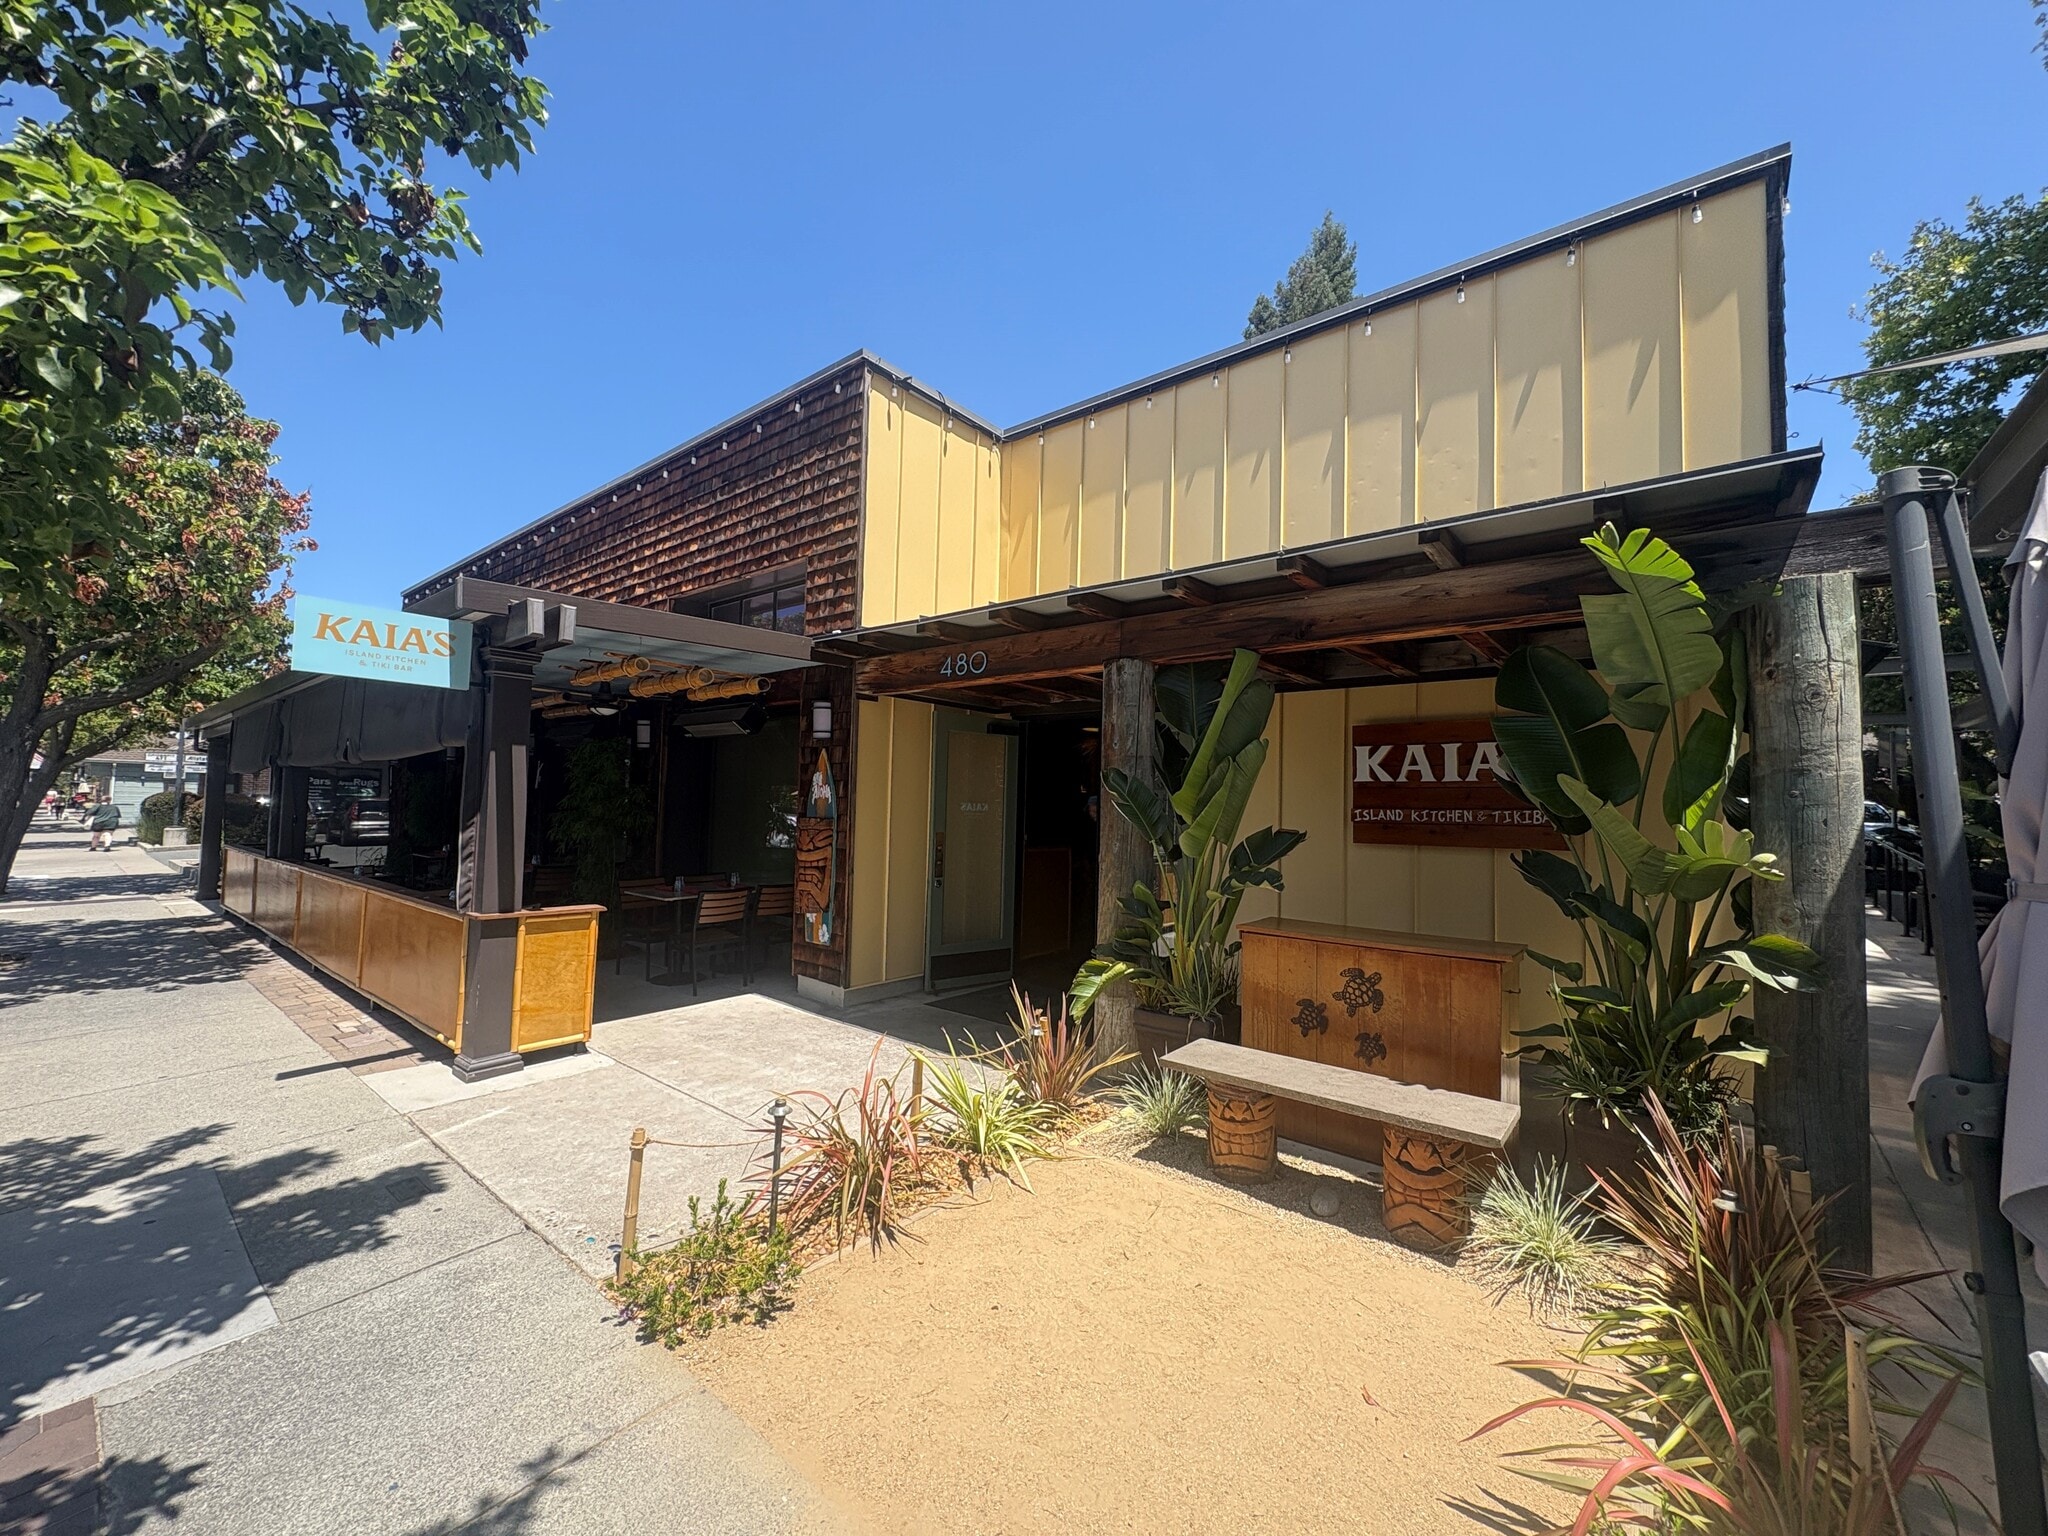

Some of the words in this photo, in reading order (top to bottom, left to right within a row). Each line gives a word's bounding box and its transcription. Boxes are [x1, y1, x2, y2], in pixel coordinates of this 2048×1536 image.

[312, 612, 457, 658] KAIA'S
[345, 649, 382, 659] ISLAND
[385, 655, 426, 665] KITCHEN
[940, 651, 987, 677] 480
[372, 661, 390, 669] TIKI
[394, 663, 413, 672] BAR
[1354, 808, 1404, 822] ISLAND
[1411, 809, 1473, 823] KITCHEN
[1476, 811, 1488, 821] &
